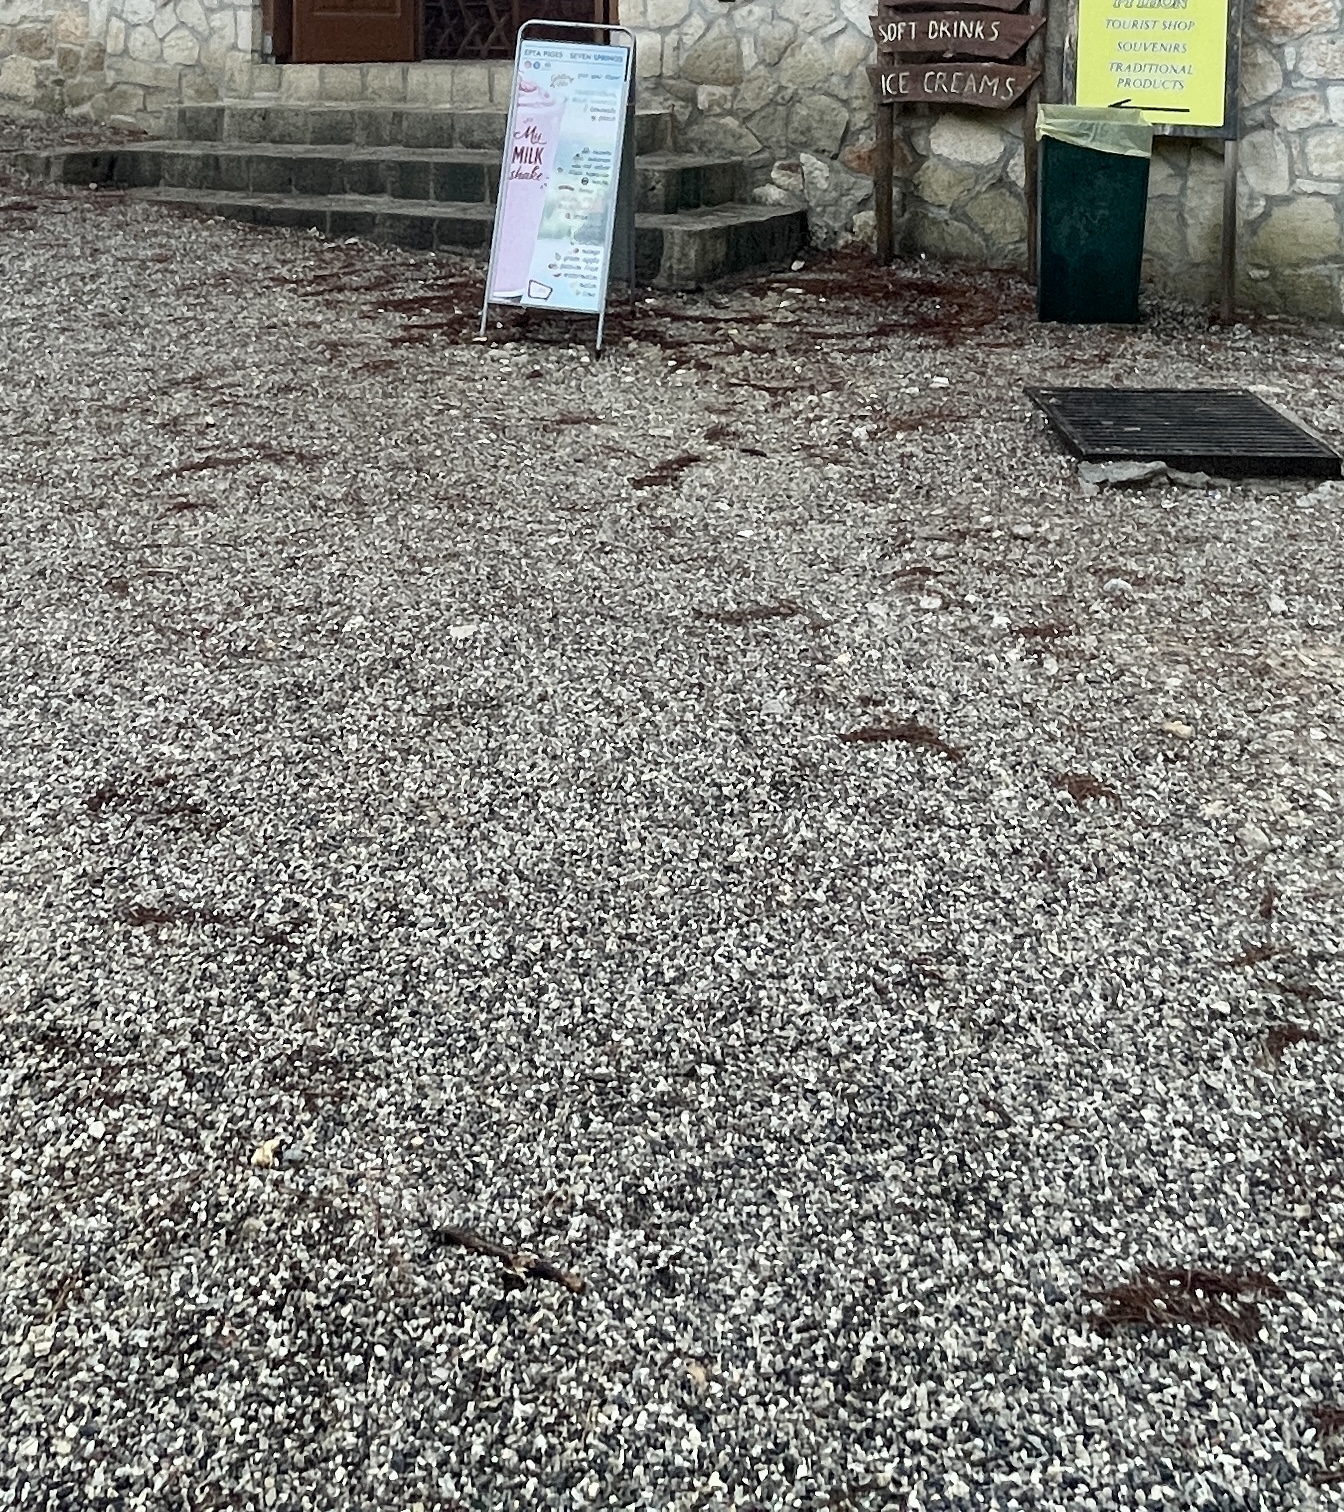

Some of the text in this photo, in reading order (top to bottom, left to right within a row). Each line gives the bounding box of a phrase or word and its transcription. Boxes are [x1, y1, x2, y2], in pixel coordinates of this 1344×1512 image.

[878, 19, 1001, 43] SOFT DRINKS
[1105, 18, 1195, 31] TOURIST SHOP
[1116, 41, 1188, 54] SOUVENIRS
[1109, 61, 1194, 75] TRADITIONAL
[881, 70, 1017, 100] ICE CREAMS
[1116, 77, 1185, 91] PRODUCTS
[513, 126, 547, 145] My
[512, 146, 545, 165] MILK
[508, 165, 543, 181] shake
